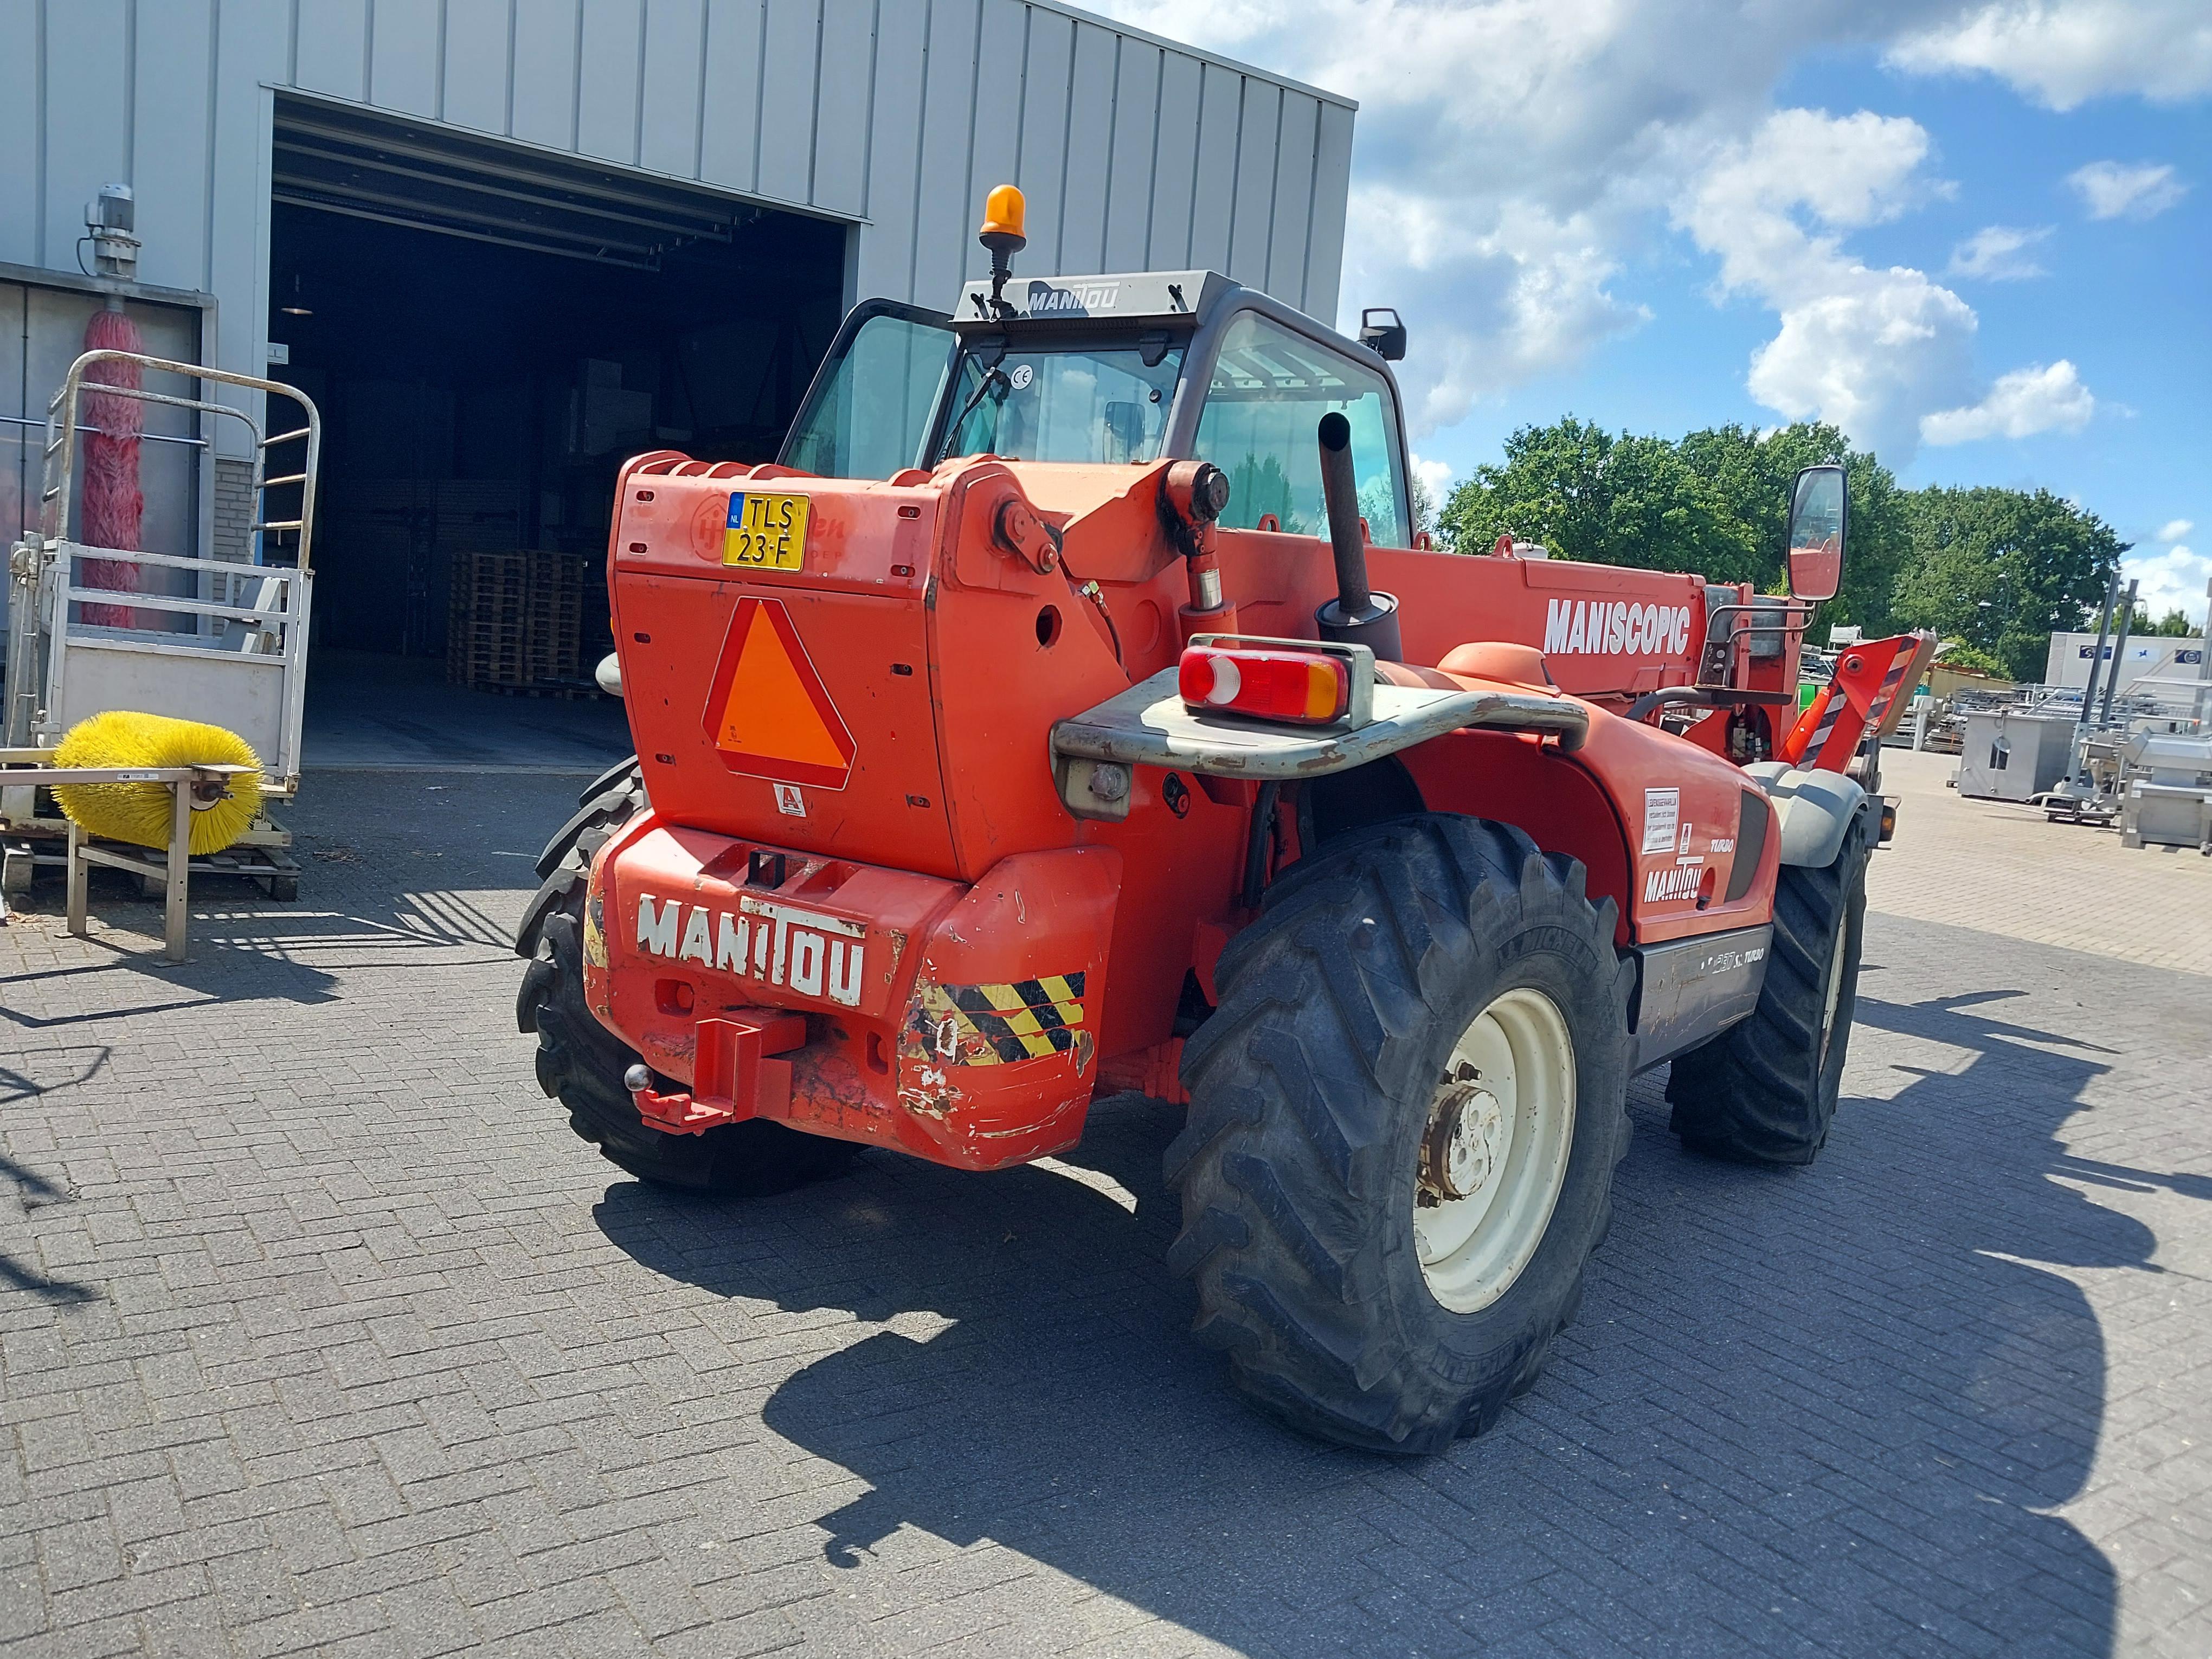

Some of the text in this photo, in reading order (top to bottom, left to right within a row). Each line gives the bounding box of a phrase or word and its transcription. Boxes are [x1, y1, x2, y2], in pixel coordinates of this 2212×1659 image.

[1029, 281, 1121, 311] MANITOU
[1013, 370, 1030, 383] CE
[731, 515, 740, 523] NL
[750, 498, 794, 529] TLS
[1543, 599, 1690, 655] MANISCOPIC
[1710, 838, 1734, 853] TURBO
[1643, 856, 1705, 903] MANITOU
[637, 892, 869, 1007] MANITOU
[1744, 947, 1764, 963] TURBO
